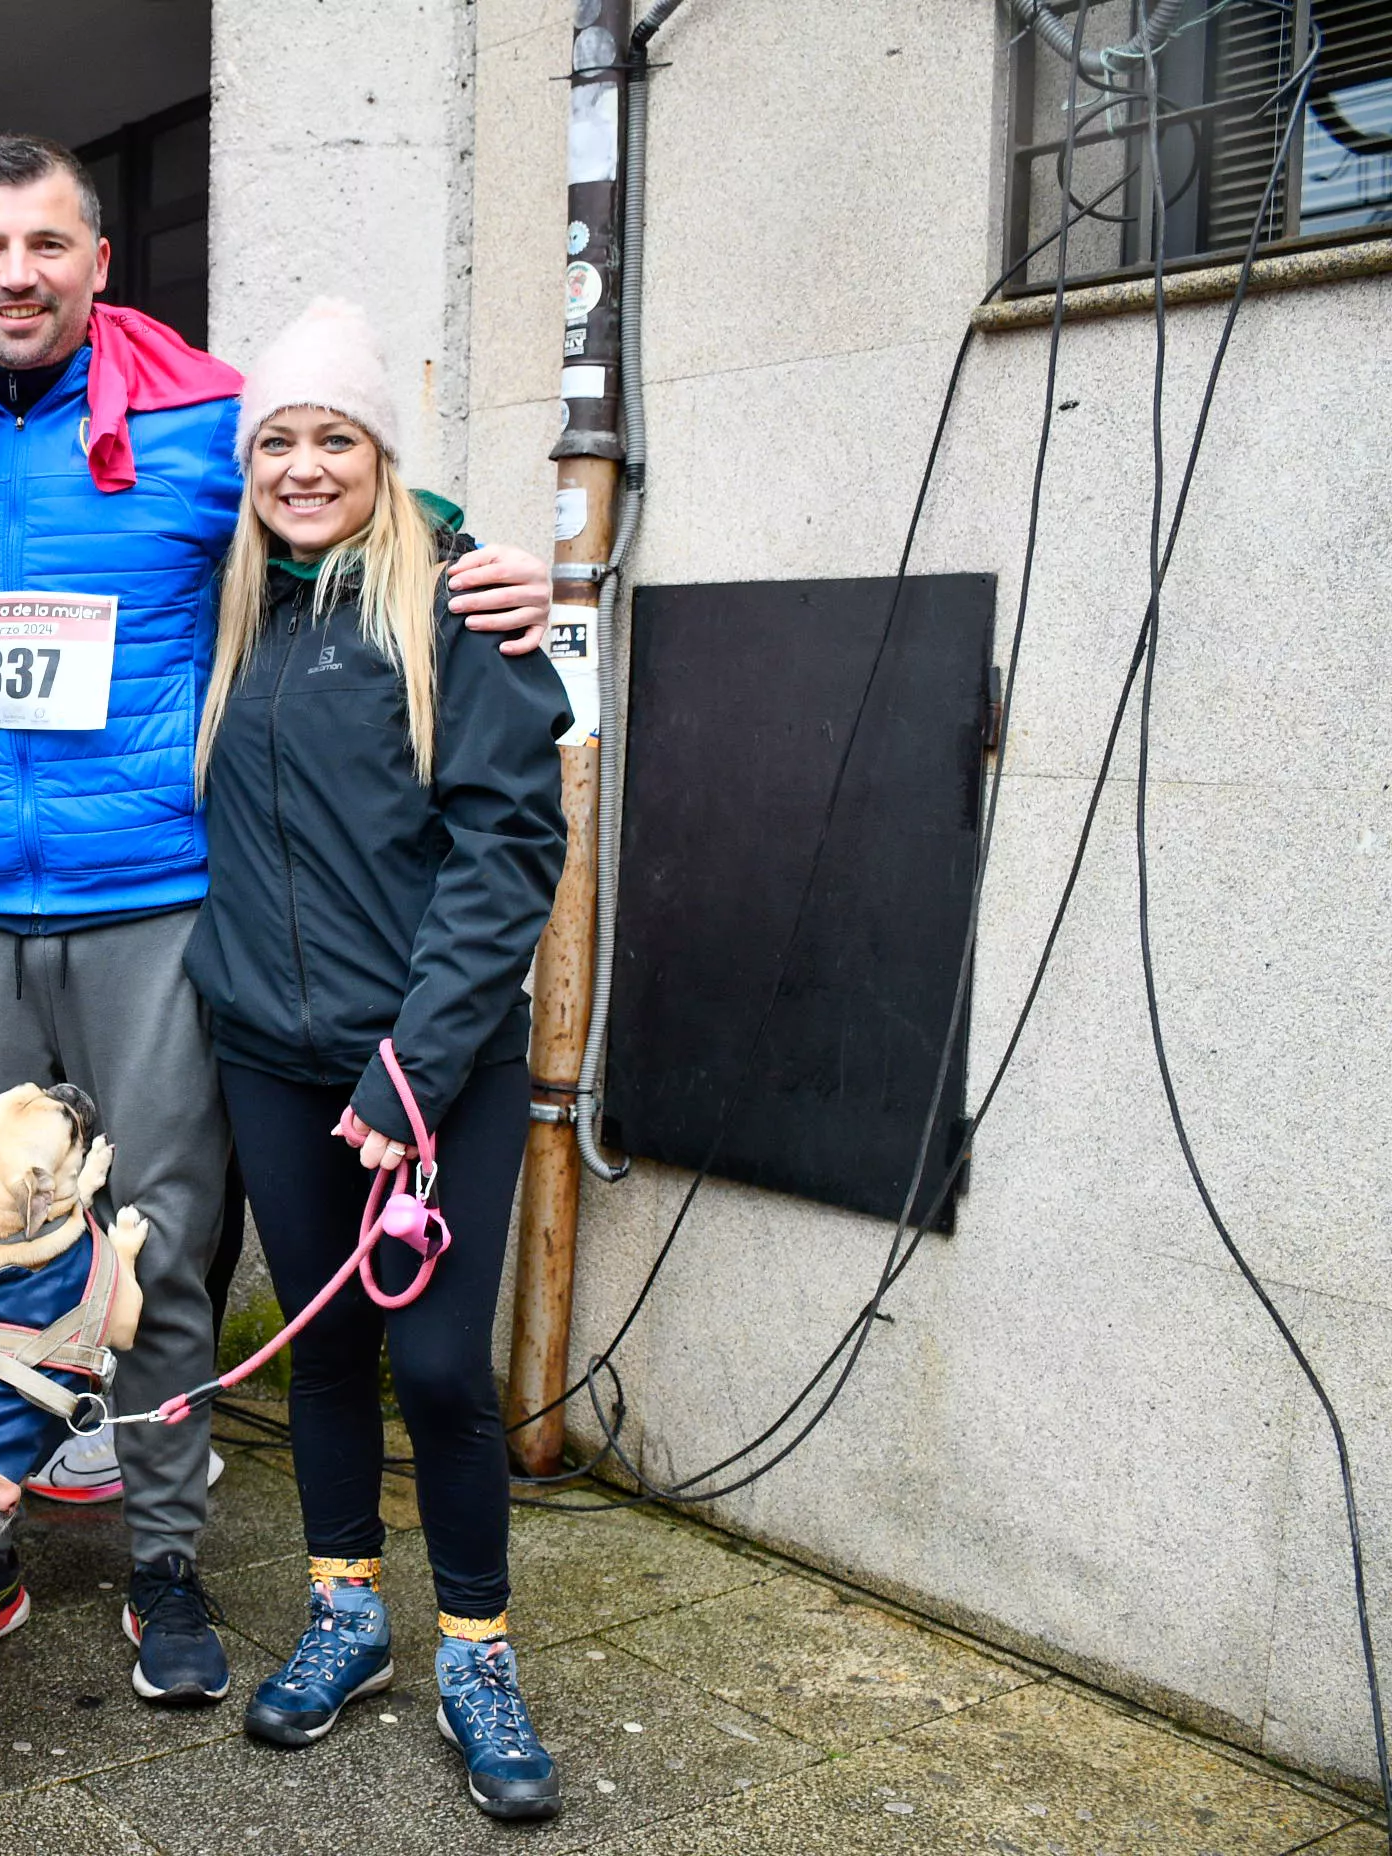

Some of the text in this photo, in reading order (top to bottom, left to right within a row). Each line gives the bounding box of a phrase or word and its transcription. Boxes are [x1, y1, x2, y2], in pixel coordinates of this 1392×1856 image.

[12, 603, 32, 617] de
[34, 603, 49, 617] la
[52, 606, 102, 622] mujer
[23, 623, 53, 635] 2024
